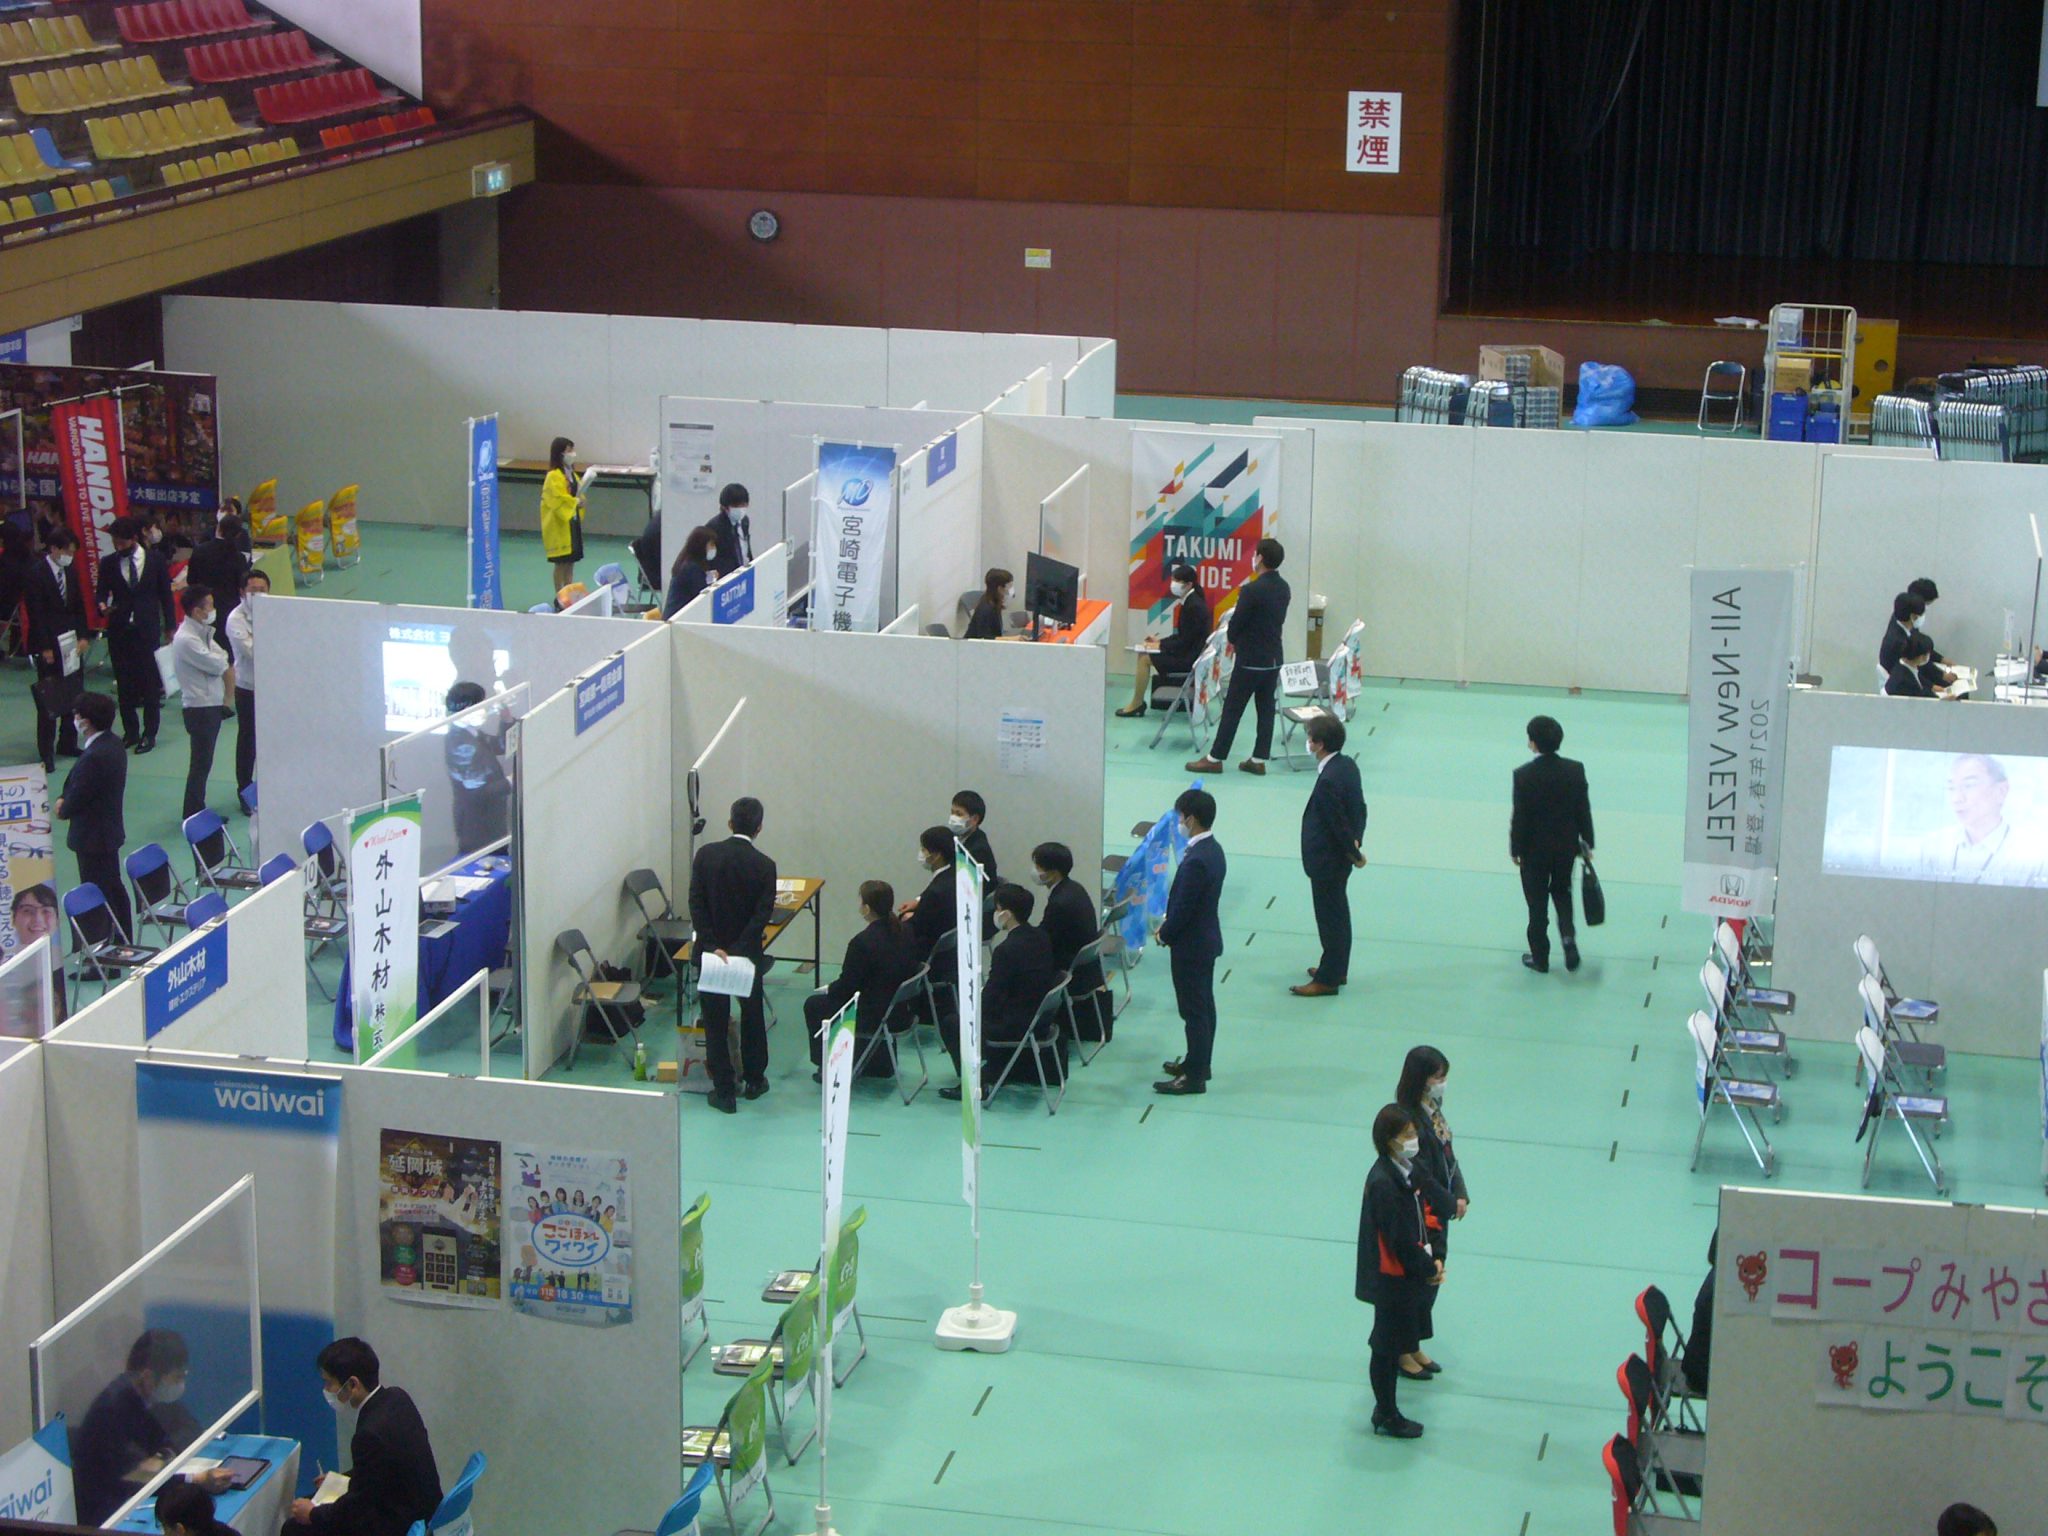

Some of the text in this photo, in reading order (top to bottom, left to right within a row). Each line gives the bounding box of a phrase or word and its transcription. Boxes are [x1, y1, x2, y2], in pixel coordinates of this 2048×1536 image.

[1356, 98, 1391, 166] 禁煙
[1163, 534, 1243, 562] TAKUMI
[832, 515, 864, 631] 宮崎電子機
[304, 862, 316, 886] 10
[370, 849, 394, 993] 外山木材
[167, 946, 207, 993] 外山木材
[214, 1084, 325, 1117] waiwai
[388, 1153, 443, 1178] 延岡城
[542, 1223, 600, 1241] ここほれ
[544, 1238, 599, 1255] ワイワイ
[1868, 1339, 2048, 1413] ようこそ
